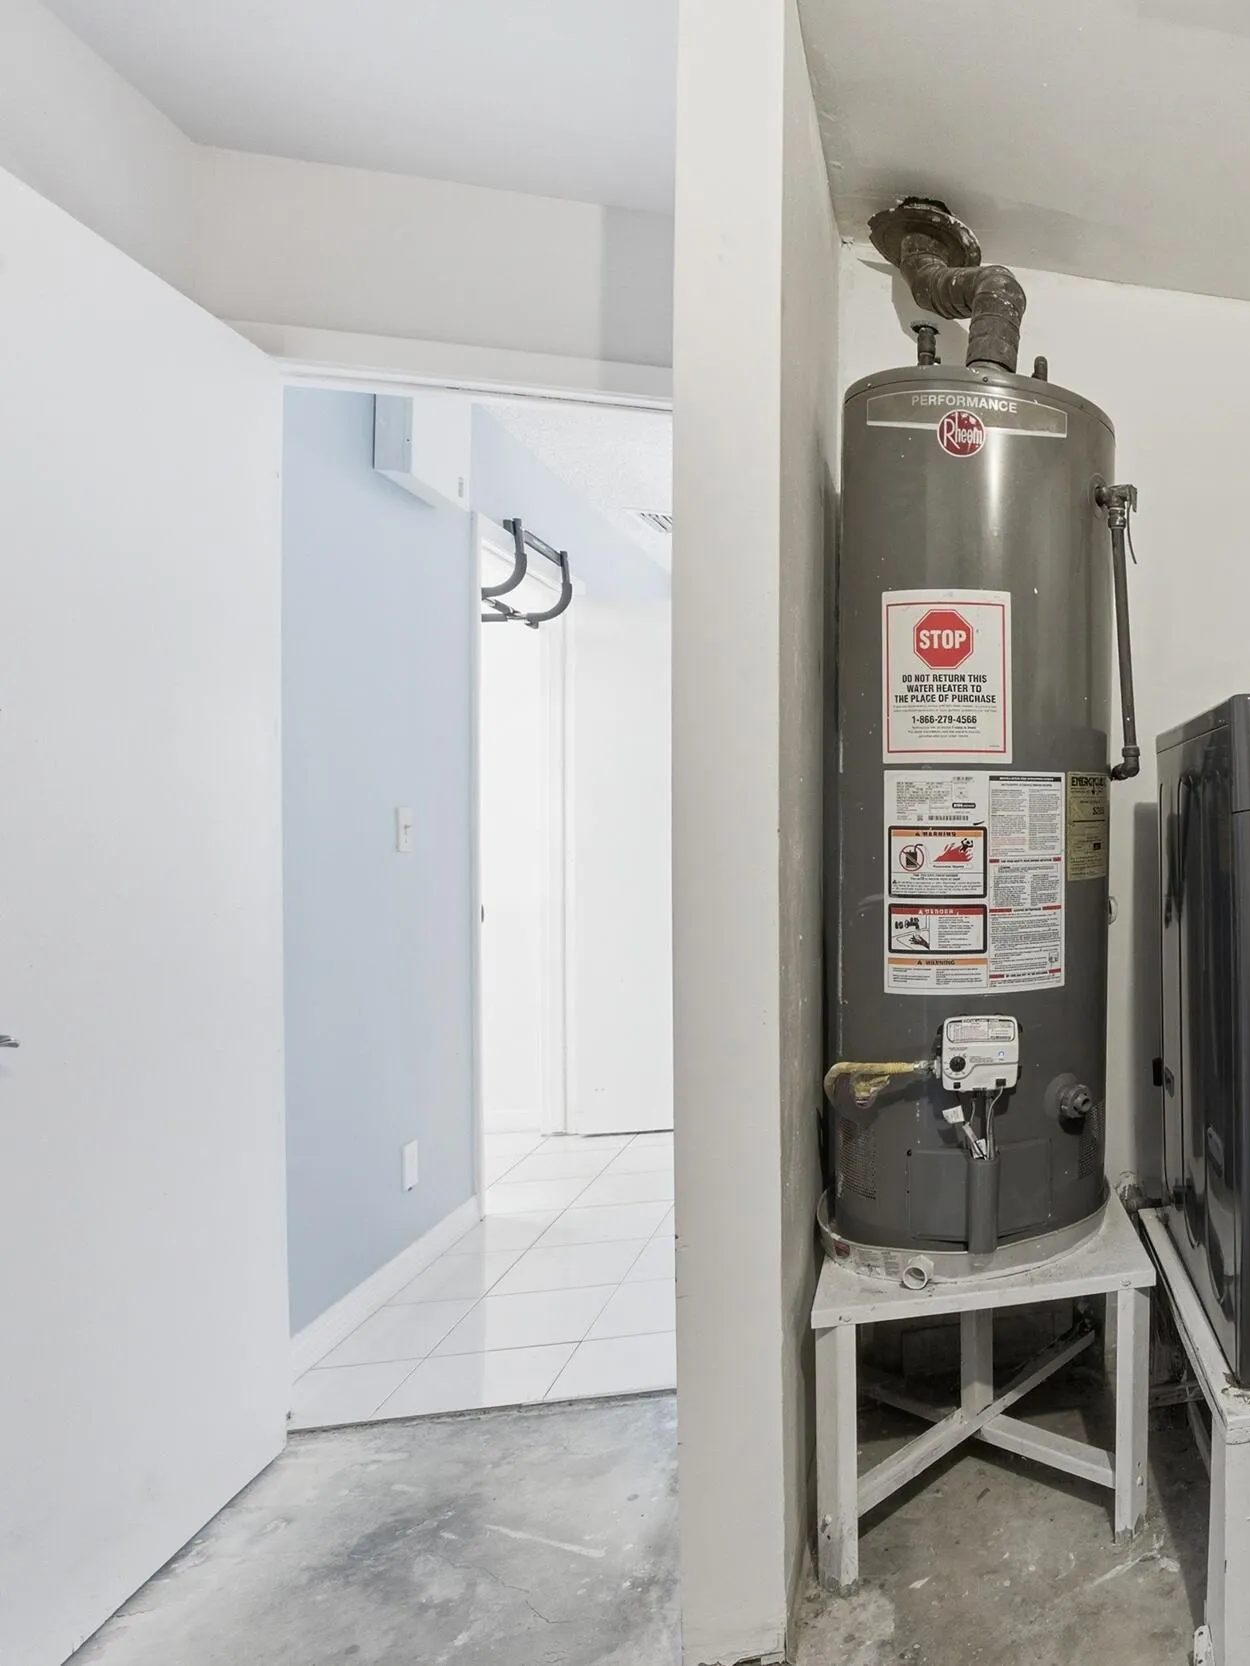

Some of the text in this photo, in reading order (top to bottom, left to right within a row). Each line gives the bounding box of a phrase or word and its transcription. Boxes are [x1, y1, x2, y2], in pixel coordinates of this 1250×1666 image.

[911, 395, 1017, 413] PERFORMANCE
[943, 411, 983, 450] Rheem
[919, 629, 967, 649] STOP
[902, 674, 987, 683] DO NOT RETURN THIS
[907, 684, 982, 693] WATER HEATER TO
[894, 694, 997, 703] THE PLACE OF PURCHASE
[911, 715, 977, 724] 1-866-279-4566
